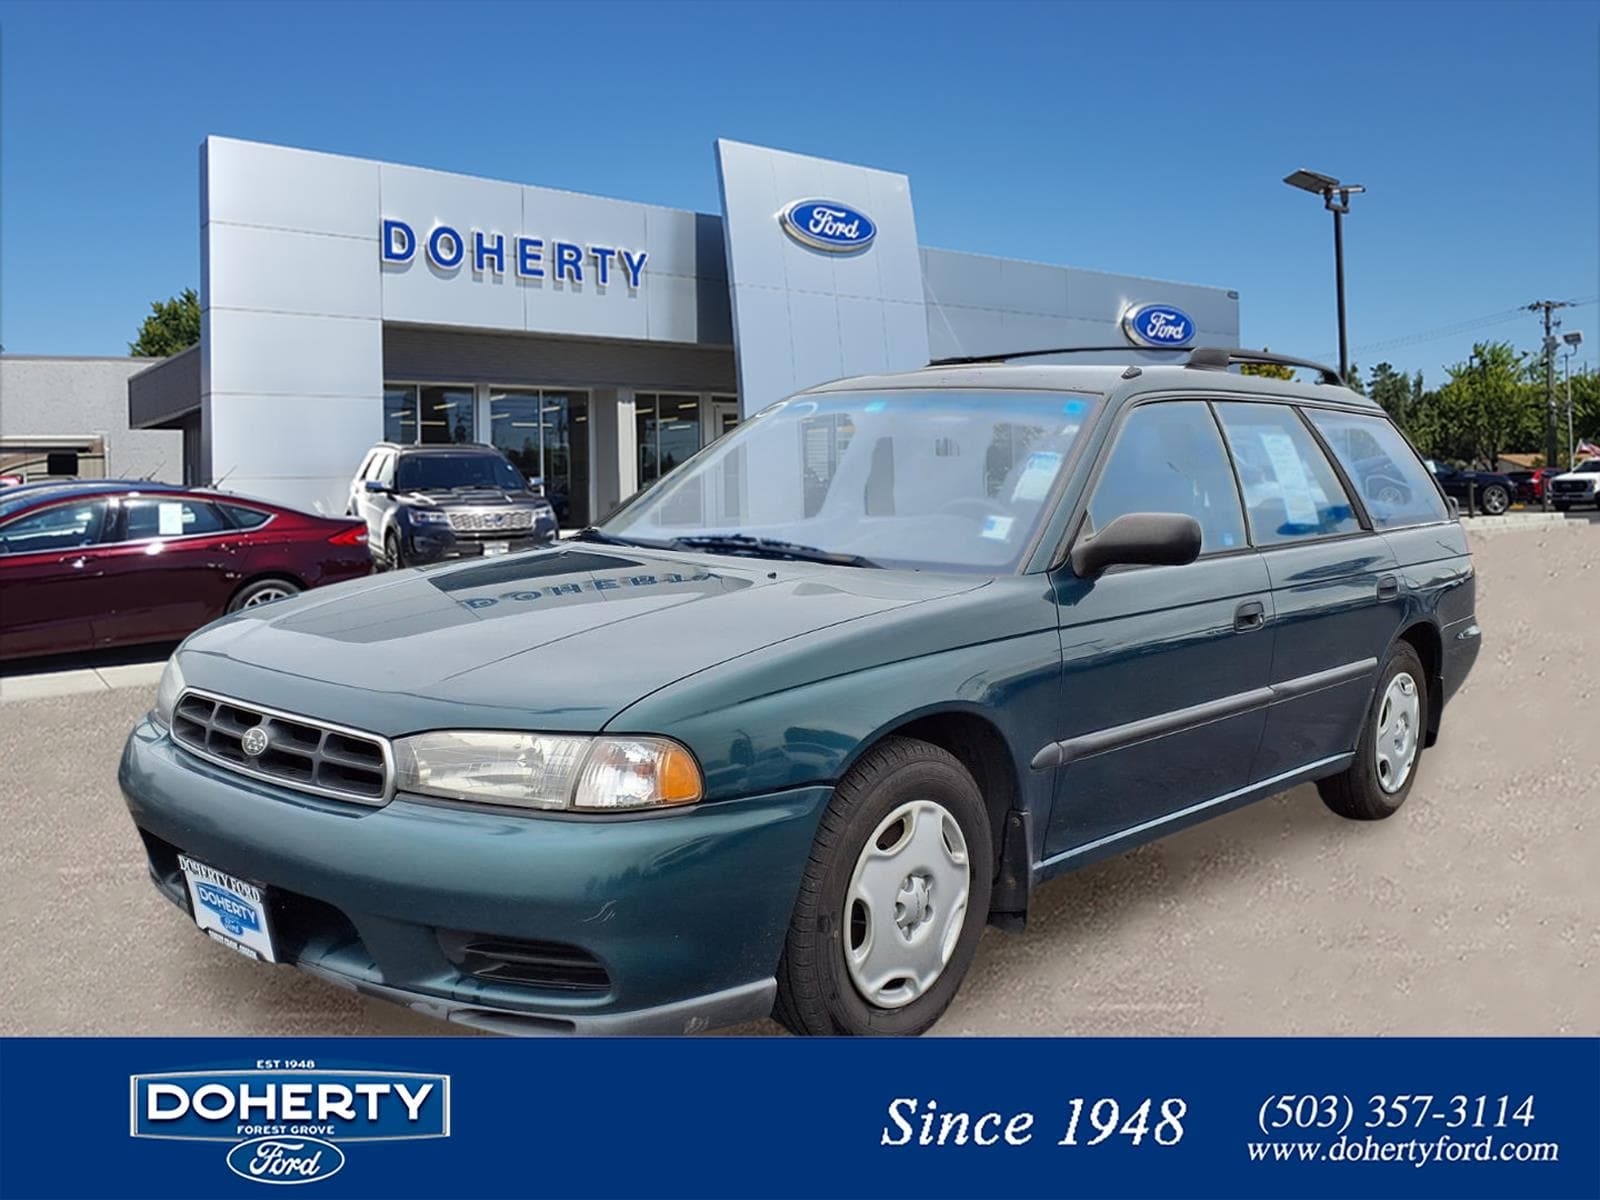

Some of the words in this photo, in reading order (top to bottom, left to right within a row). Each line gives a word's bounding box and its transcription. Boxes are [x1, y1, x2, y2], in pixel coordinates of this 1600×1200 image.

[808, 207, 859, 239] Ford
[382, 218, 648, 289] DOHERTY
[1146, 311, 1186, 340] Ford
[178, 856, 229, 888] DOHERTY
[230, 879, 261, 903] FORD
[199, 886, 257, 924] DOHERTY
